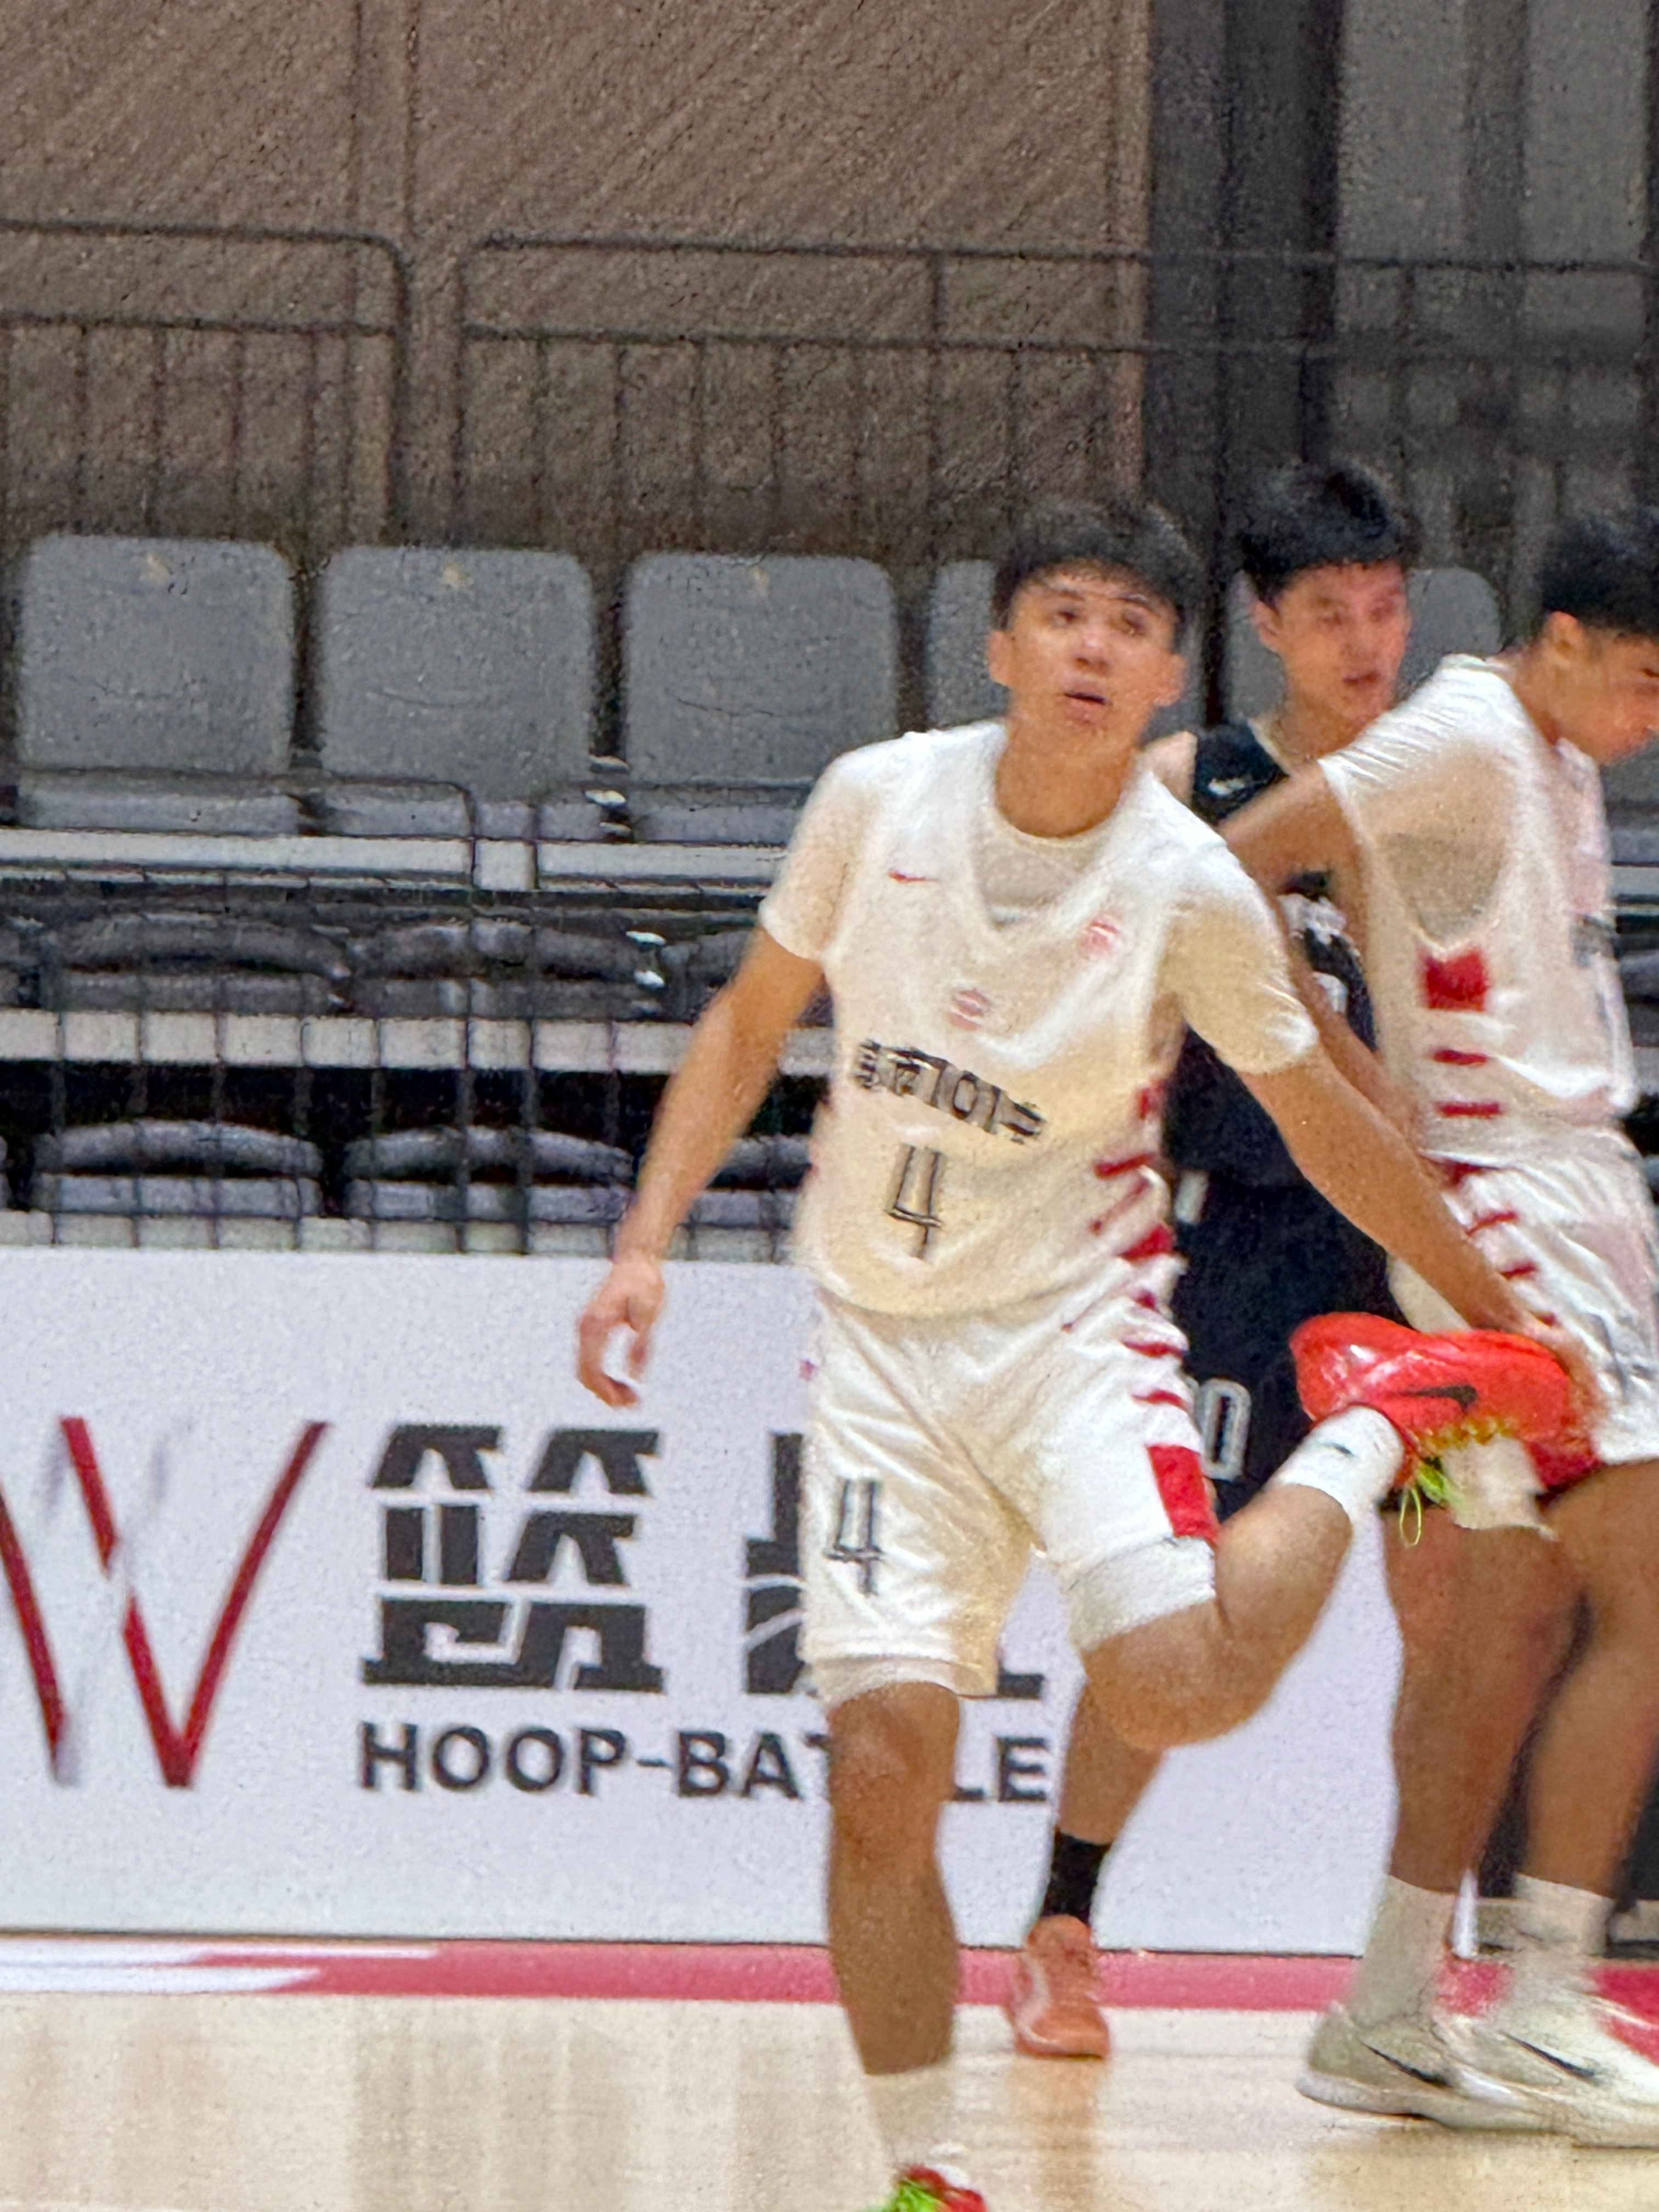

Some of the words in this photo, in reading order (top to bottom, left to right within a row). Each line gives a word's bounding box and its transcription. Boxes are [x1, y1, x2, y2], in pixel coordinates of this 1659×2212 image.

[1185, 1374, 1252, 1483] 0
[826, 1478, 884, 1595] 4
[359, 1722, 1048, 1803] HOOP-BAE
